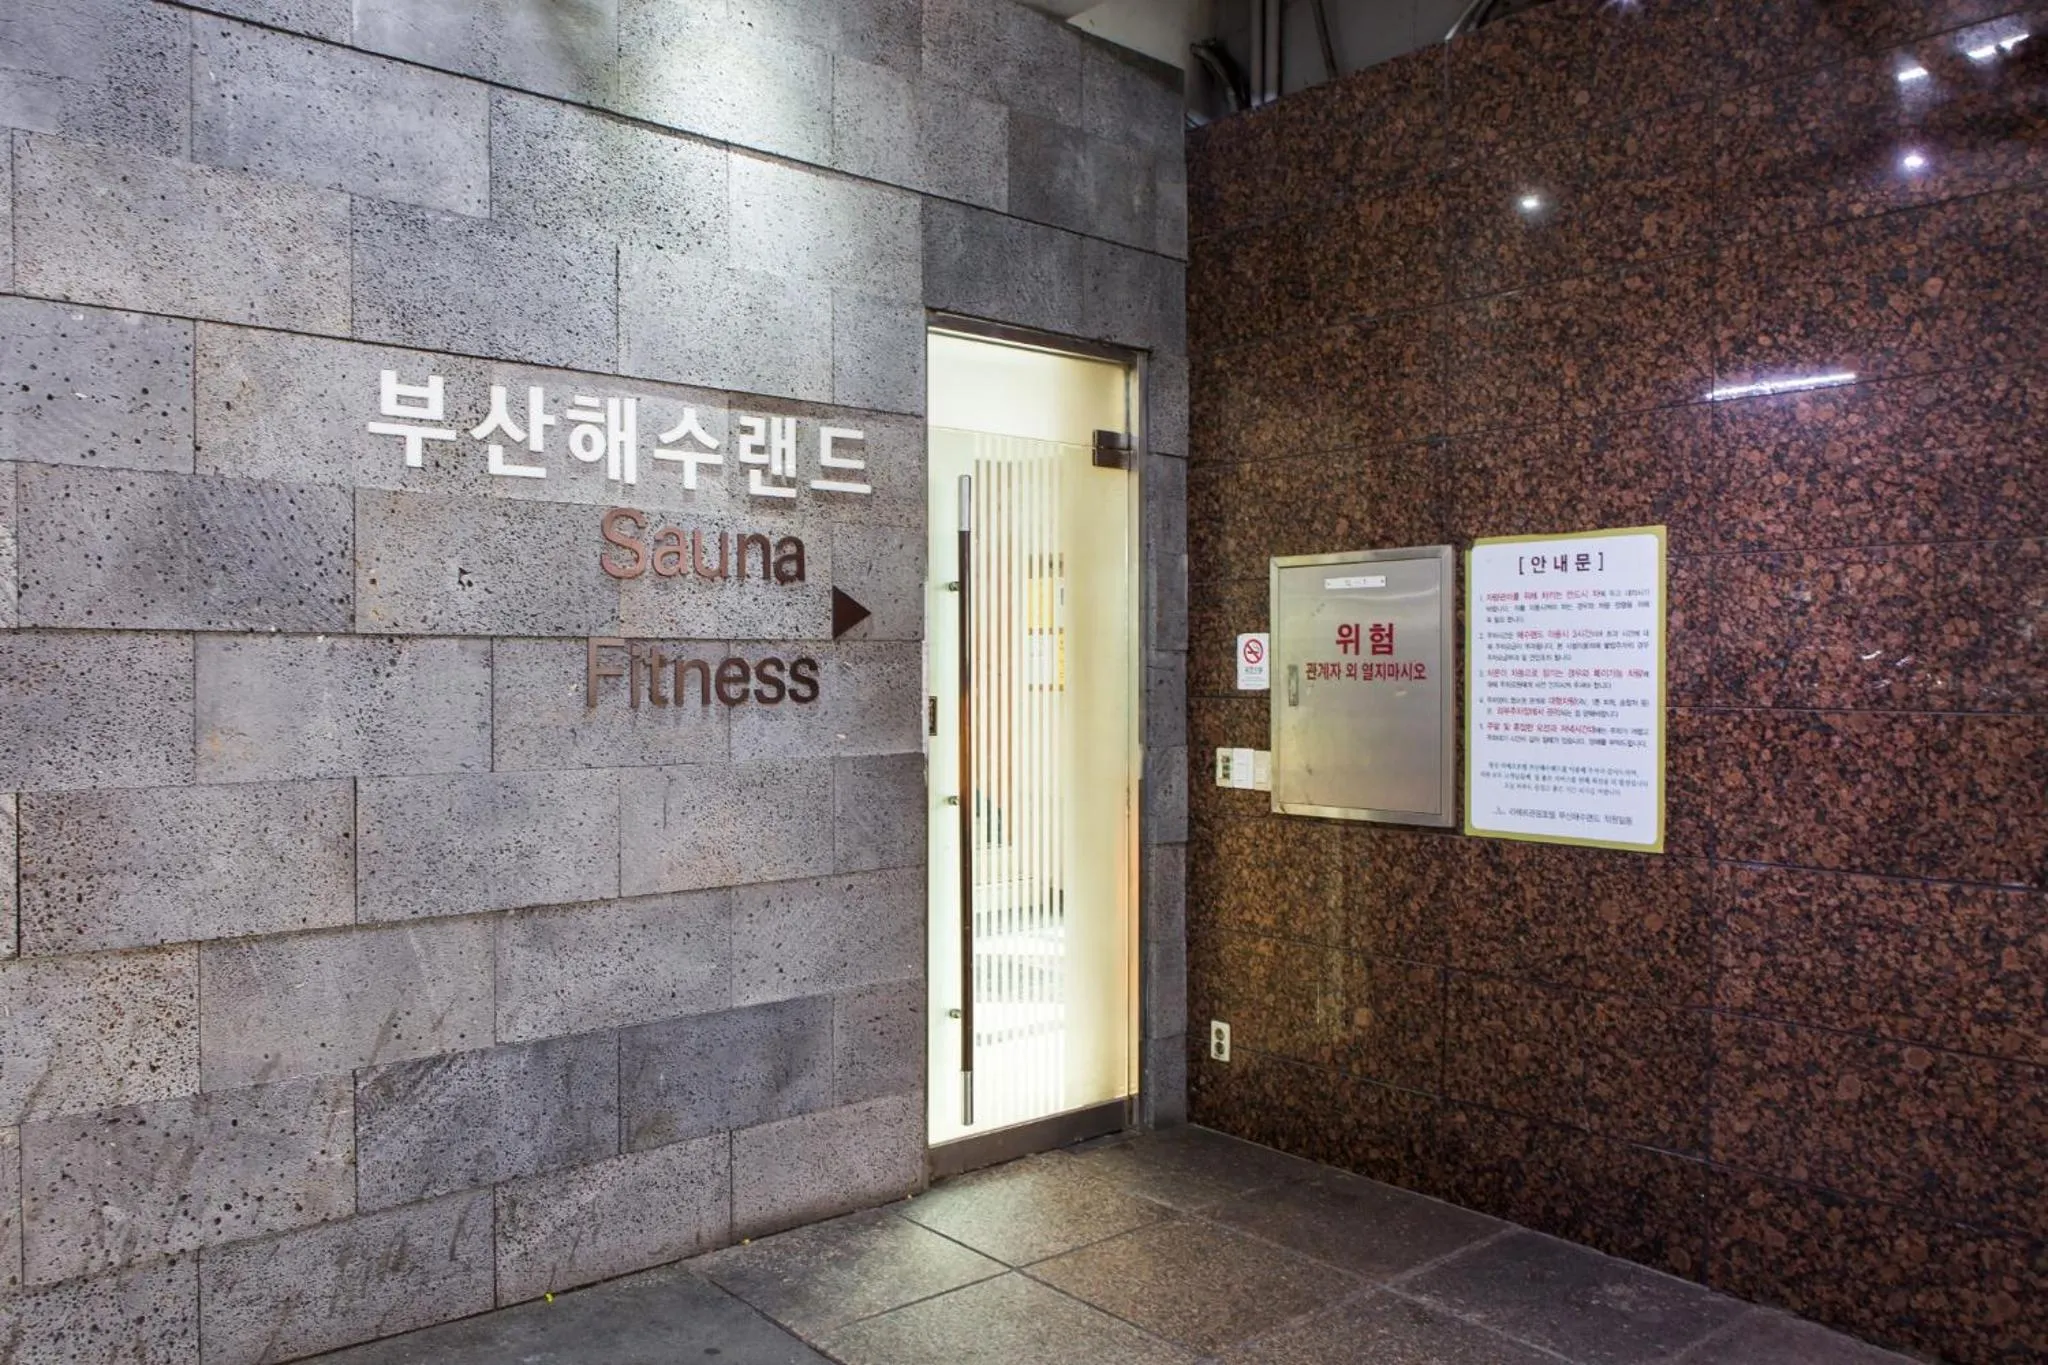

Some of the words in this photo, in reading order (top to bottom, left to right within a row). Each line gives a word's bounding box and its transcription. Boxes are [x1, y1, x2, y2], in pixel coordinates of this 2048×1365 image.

[368, 368, 872, 498] 부산해수랜드
[600, 507, 806, 583] Sauna
[587, 637, 821, 709] Fitness
[1305, 662, 1341, 681] 관계자
[1345, 663, 1358, 680] 외
[1361, 662, 1428, 682] 열지마시오
[1335, 622, 1395, 656] 위험
